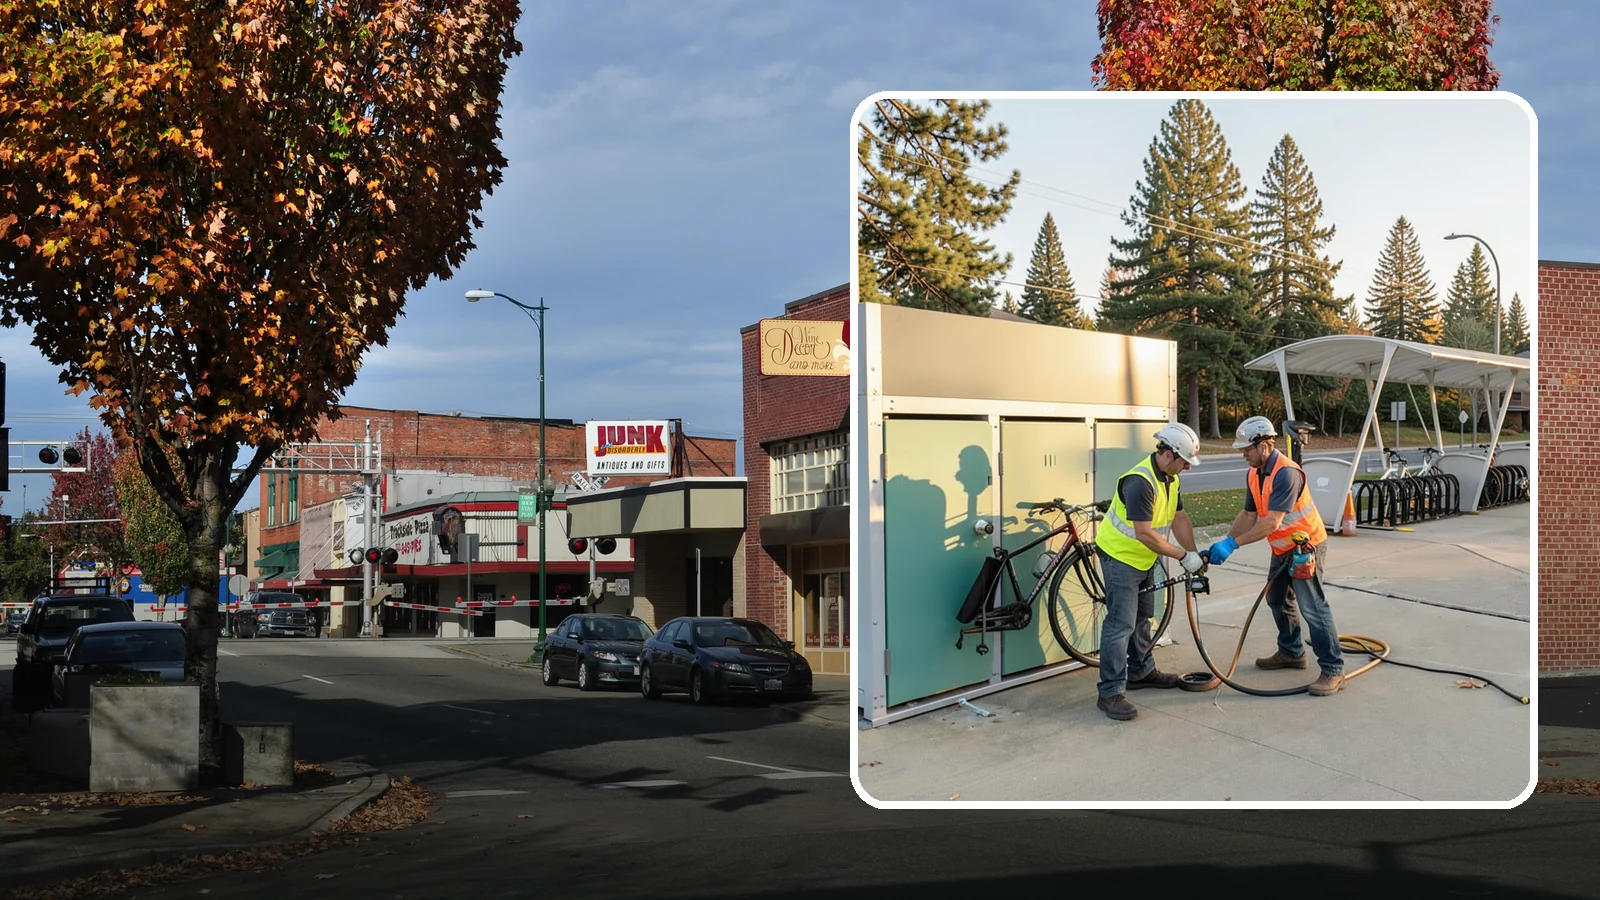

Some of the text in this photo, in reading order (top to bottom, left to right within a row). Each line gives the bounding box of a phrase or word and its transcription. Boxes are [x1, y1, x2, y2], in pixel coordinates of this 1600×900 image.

[765, 328, 831, 365] Decor
[595, 425, 665, 457] JUNK
[607, 446, 646, 454] DISORDERLY
[597, 461, 665, 470] ANTIQUES AND GIFTS
[415, 520, 429, 534] Pizza
